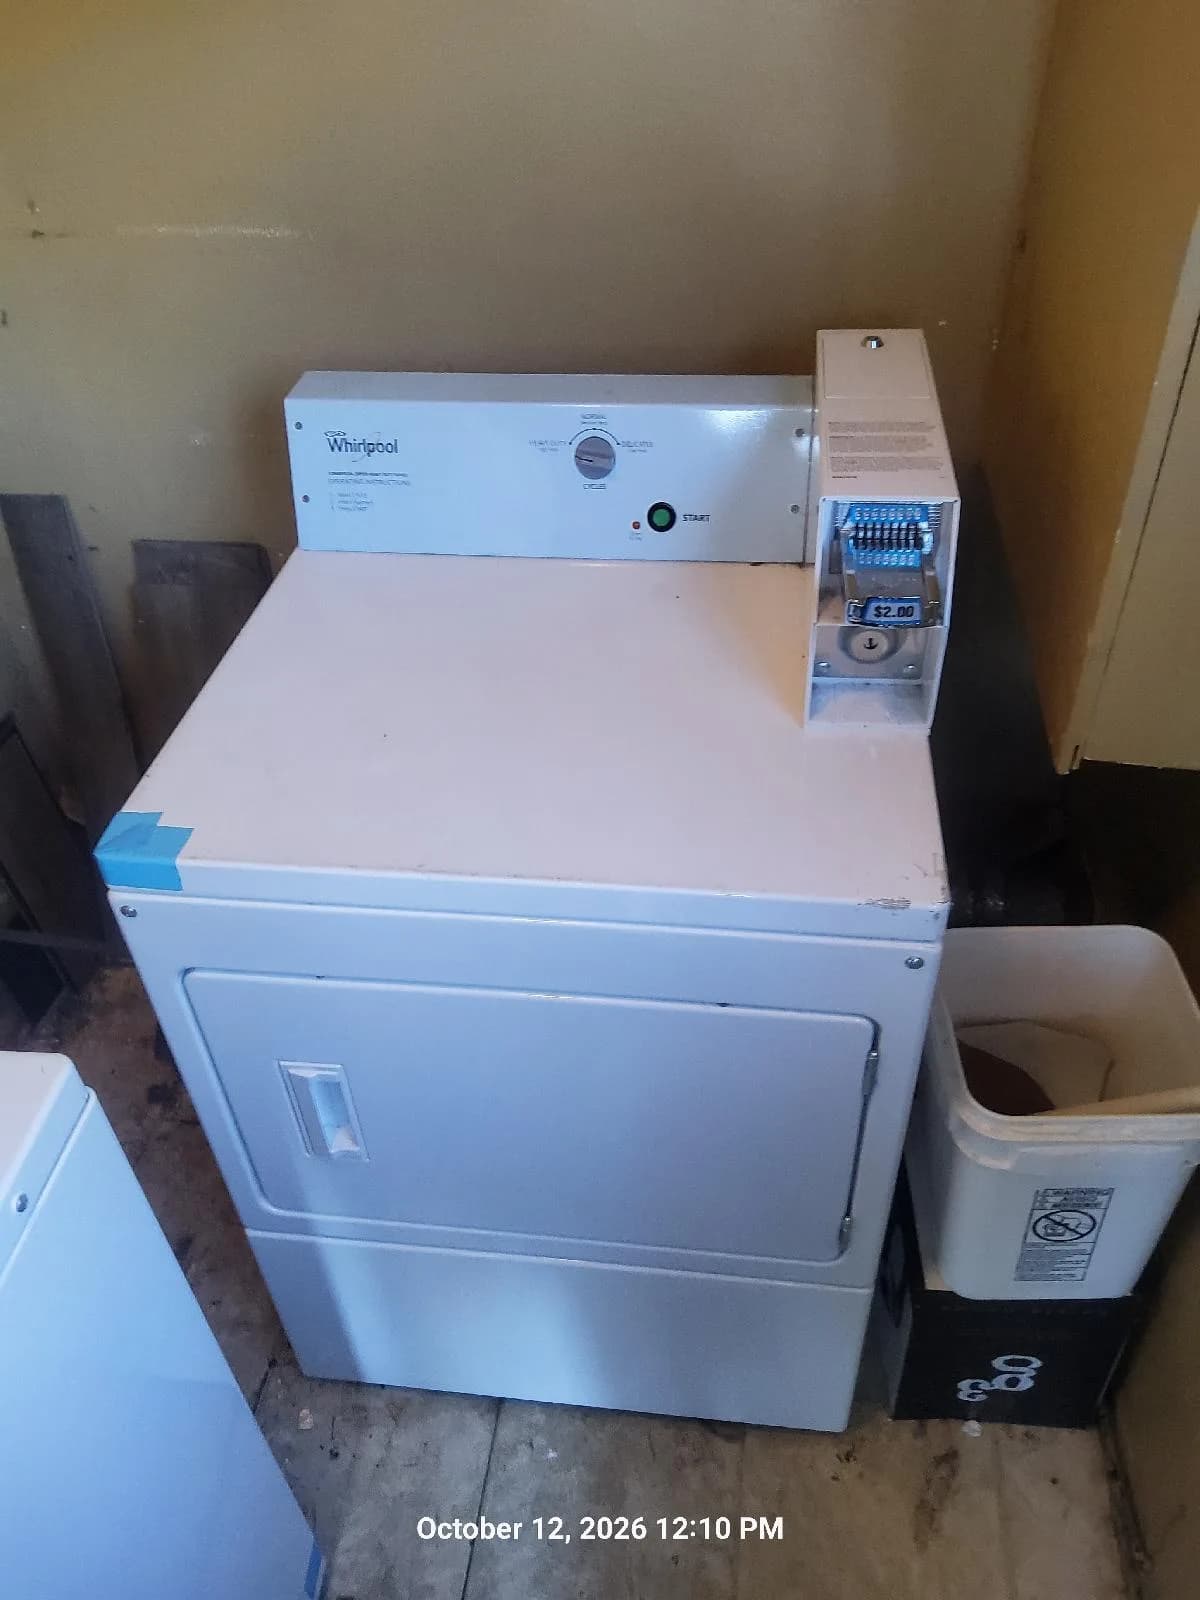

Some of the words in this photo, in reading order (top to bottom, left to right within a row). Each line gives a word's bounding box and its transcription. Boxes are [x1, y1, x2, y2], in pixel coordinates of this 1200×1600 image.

[326, 437, 399, 458] Whirlpool
[682, 514, 711, 522] START
[873, 605, 915, 618] $2.00
